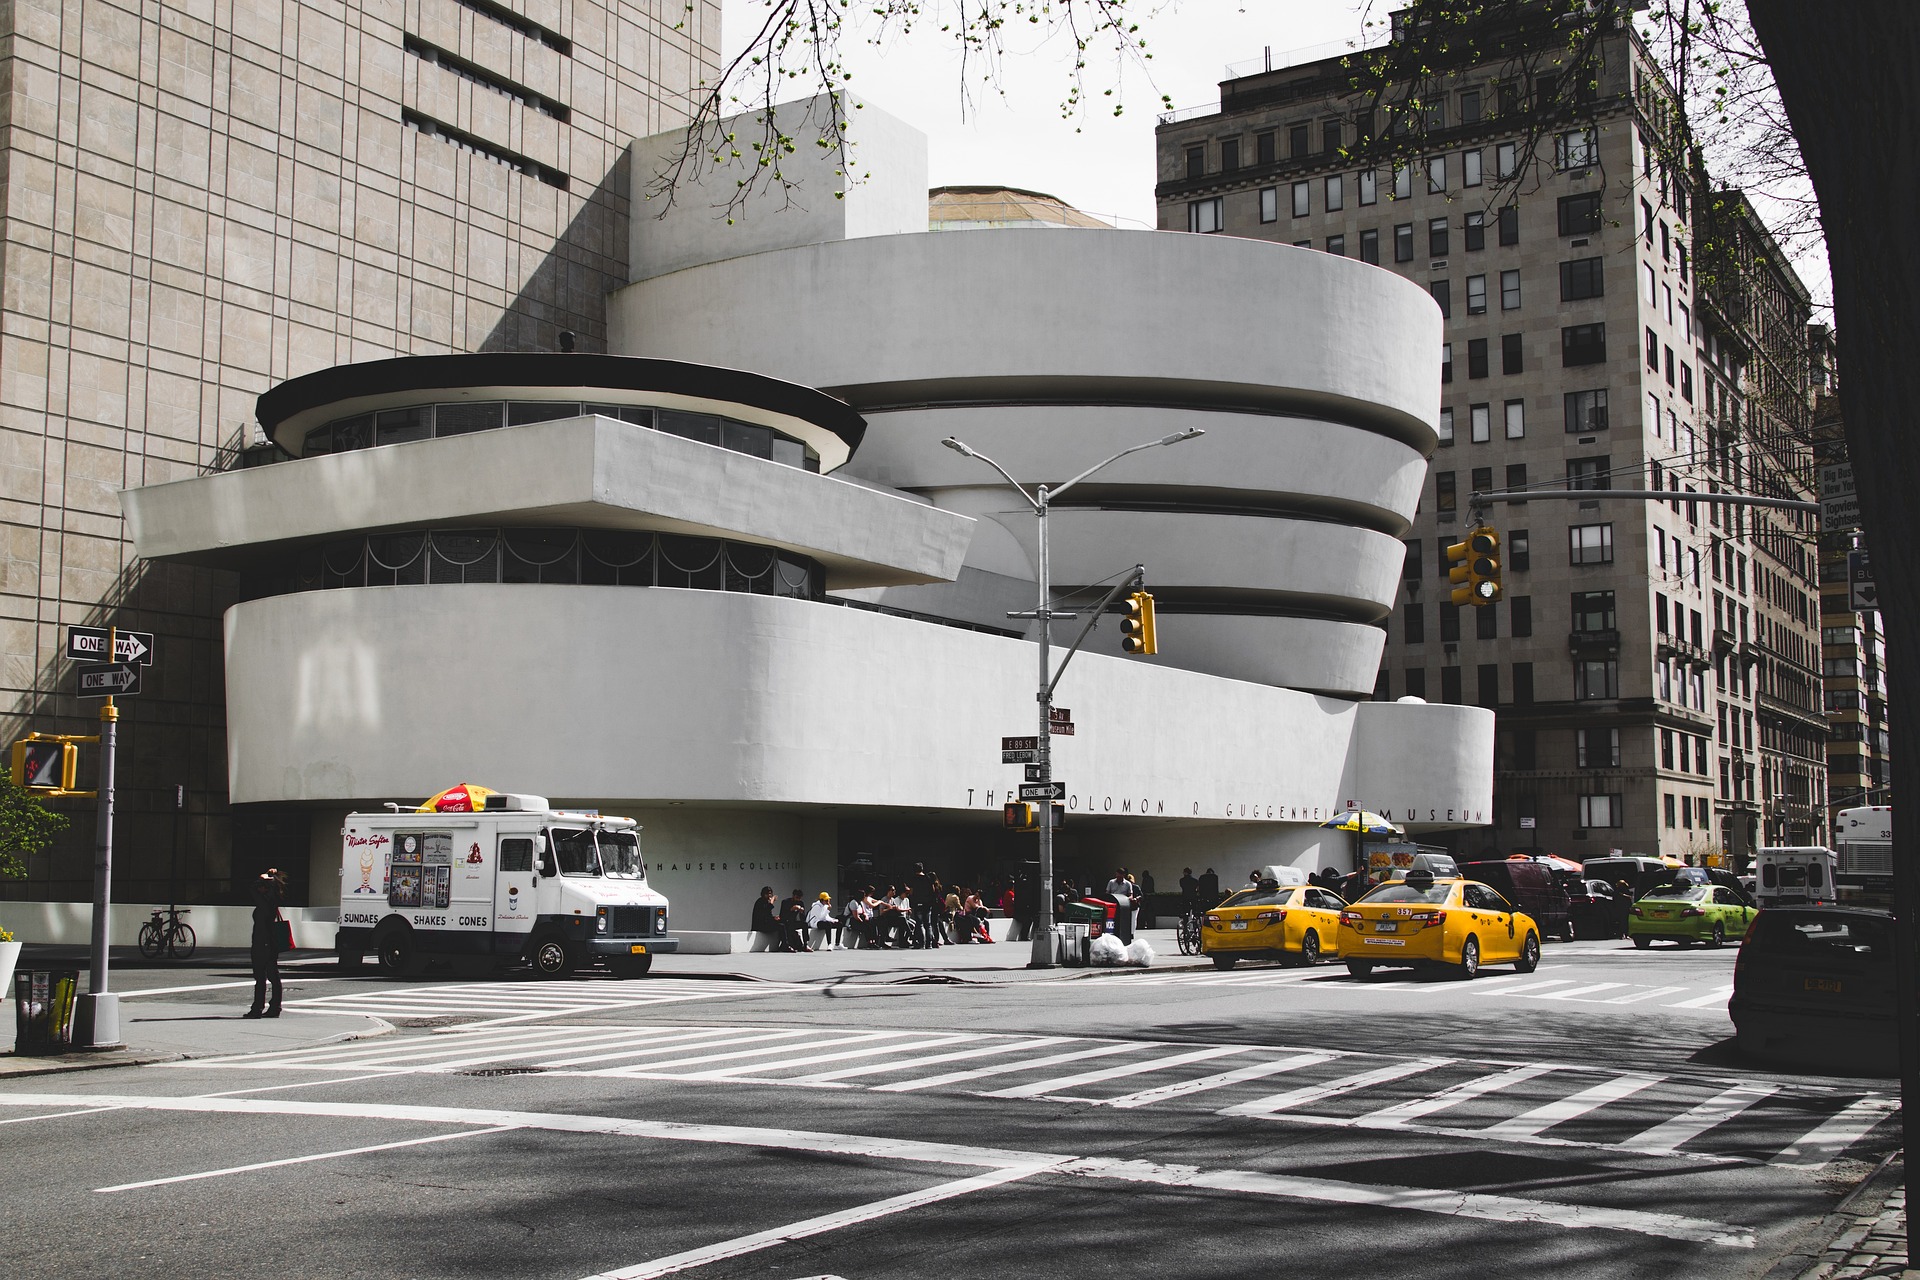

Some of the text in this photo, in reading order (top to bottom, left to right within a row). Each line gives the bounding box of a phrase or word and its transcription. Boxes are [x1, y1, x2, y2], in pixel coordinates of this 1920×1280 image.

[1824, 468, 1852, 482] Big Bus
[1825, 480, 1857, 495] New Yor
[1825, 513, 1862, 529] Sightsee
[80, 637, 140, 654] ONE WAY
[86, 672, 131, 686] ONE WAY
[1014, 740, 1023, 749] 89
[1025, 739, 1032, 749] St
[1002, 751, 1015, 759] FRED
[1025, 787, 1057, 796] ONE WAY
[1069, 795, 1164, 814] OLOMON
[1193, 801, 1199, 815] R
[1379, 809, 1482, 822] MUSEUM
[1880, 830, 1892, 838] 33
[344, 913, 487, 927] SUNDAES SHAKES CONES
